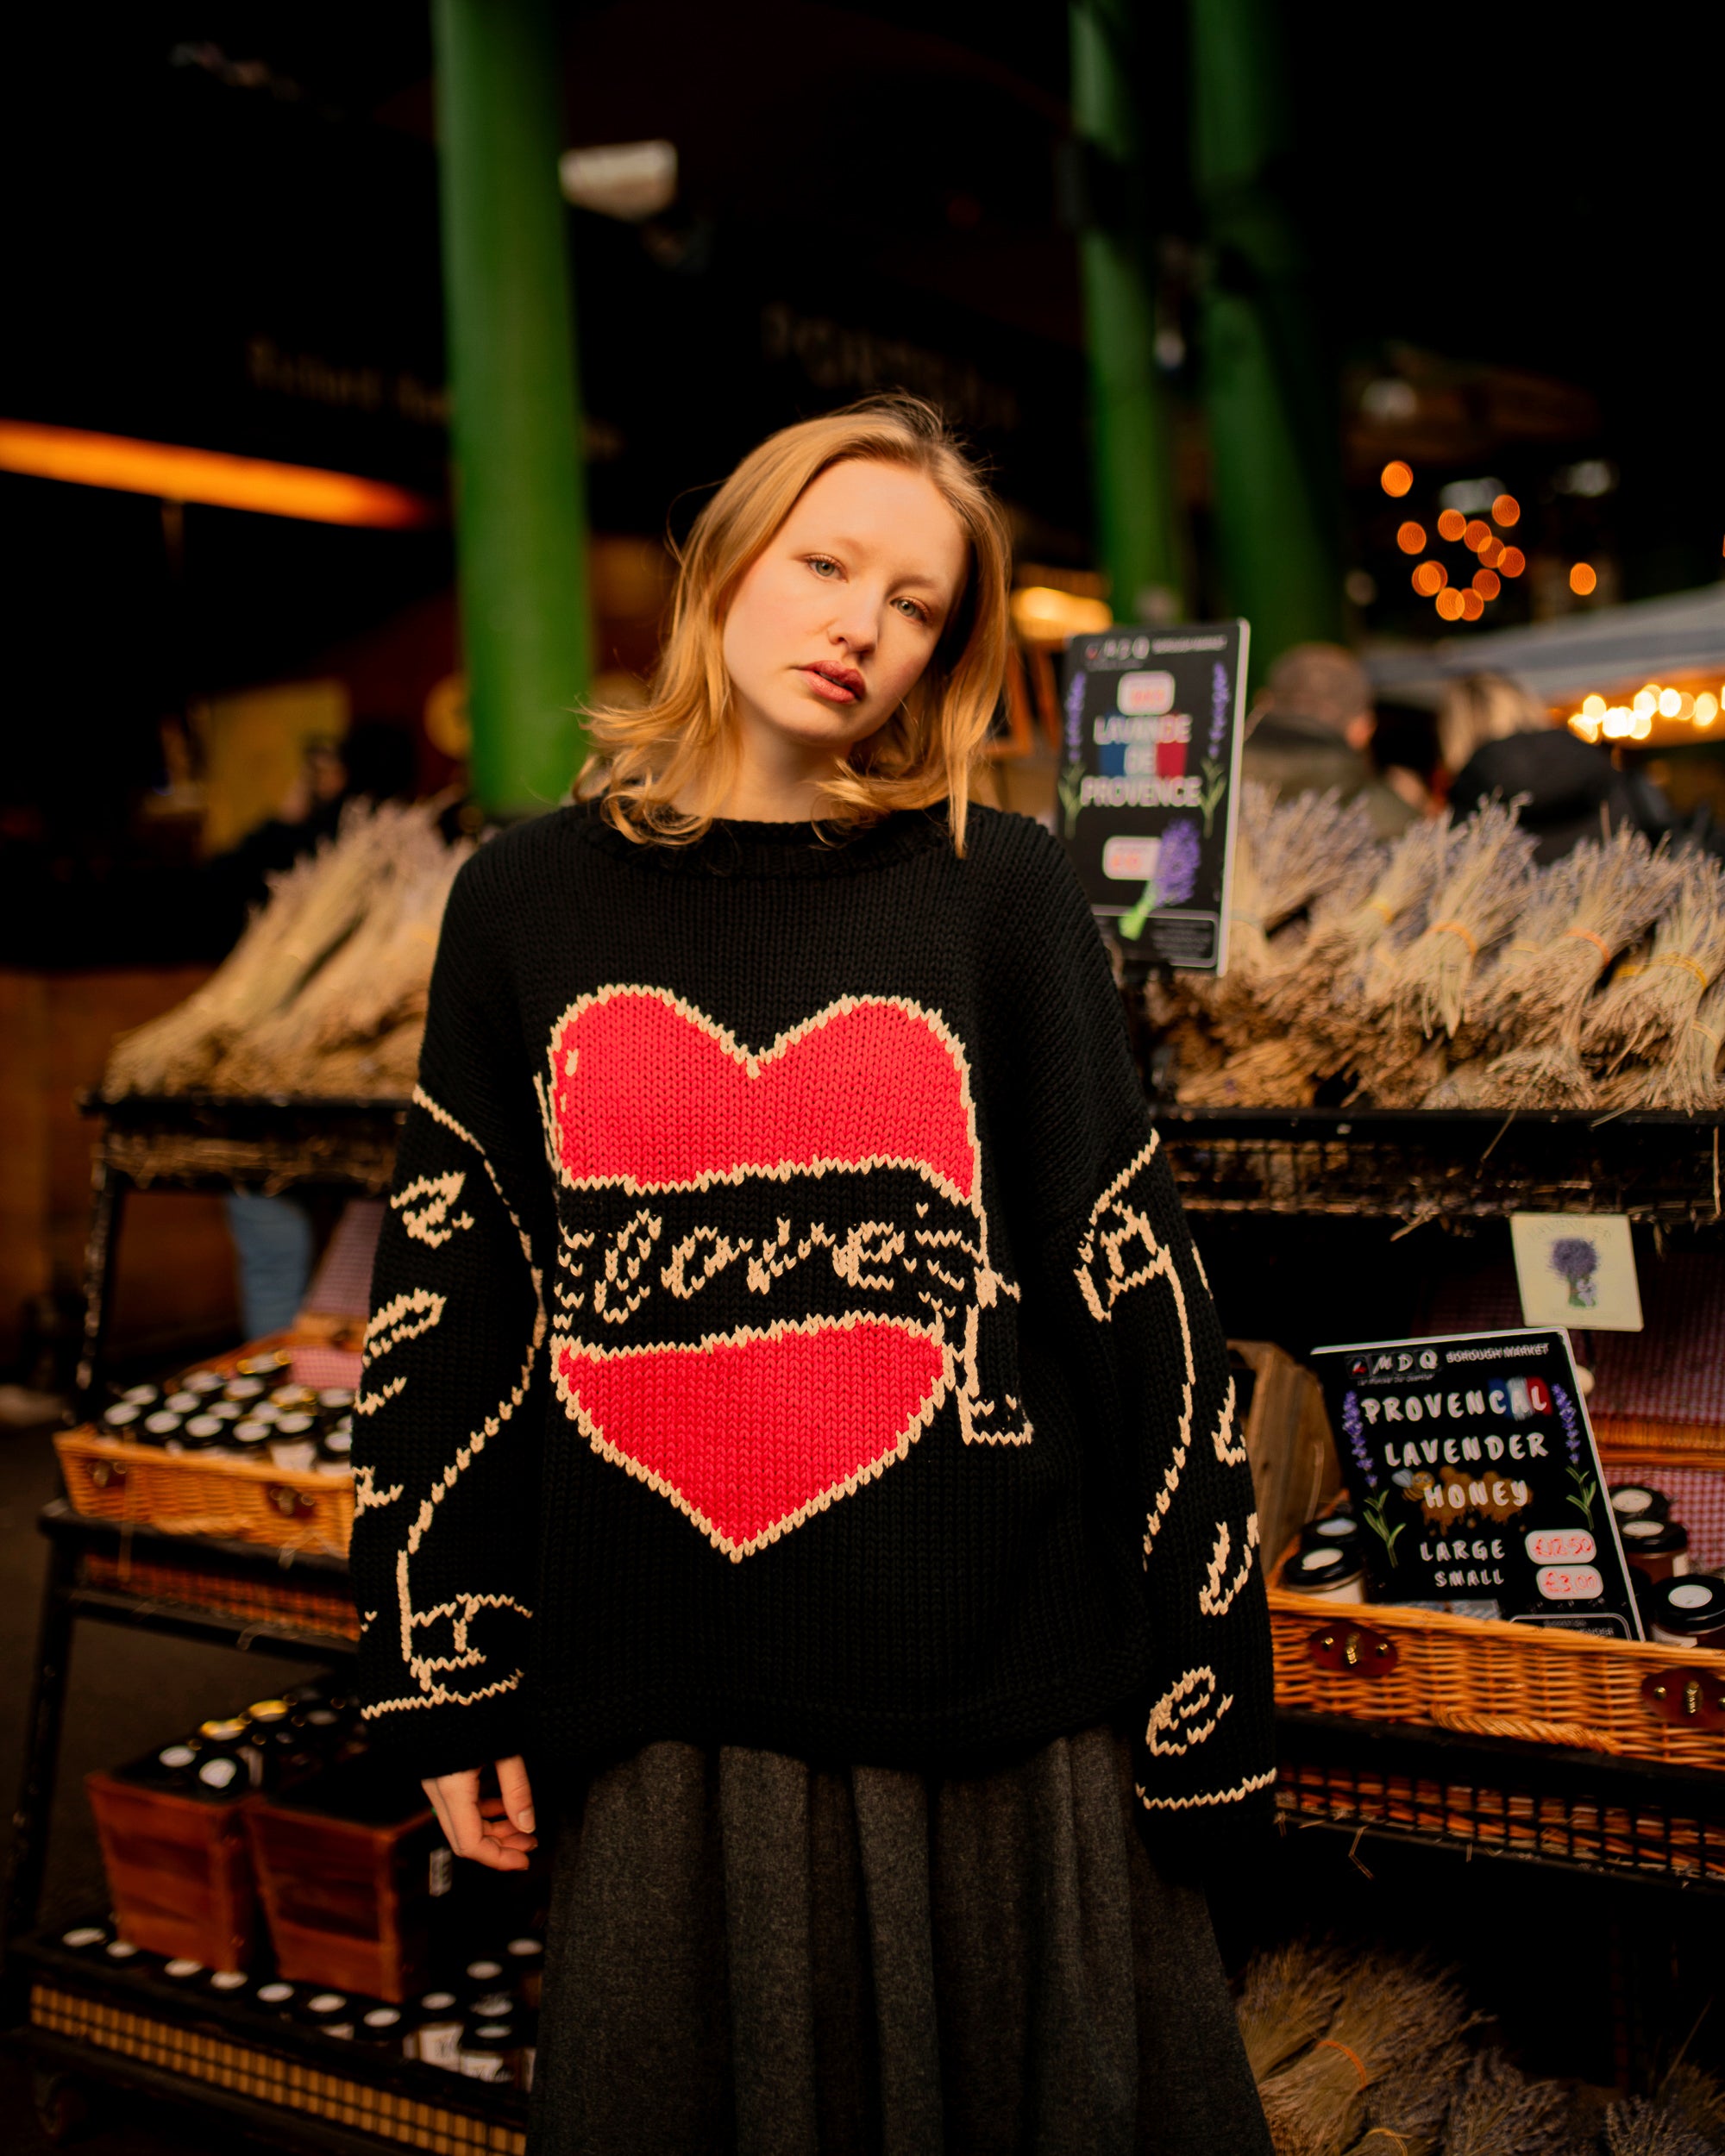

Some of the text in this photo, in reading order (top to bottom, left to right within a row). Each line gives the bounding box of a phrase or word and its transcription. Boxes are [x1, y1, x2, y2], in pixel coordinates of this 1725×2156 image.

[1080, 776, 1202, 807] PROVENCE
[1446, 1346, 1503, 1363] BOROUGH
[1503, 1342, 1550, 1358] MARKET
[1360, 1386, 1547, 1424] PROVENCAL
[1384, 1432, 1549, 1467] LAVENDER
[1423, 1479, 1529, 1509] HONEY
[1420, 1539, 1506, 1562] LARGE
[1434, 1569, 1505, 1587] SMALL
